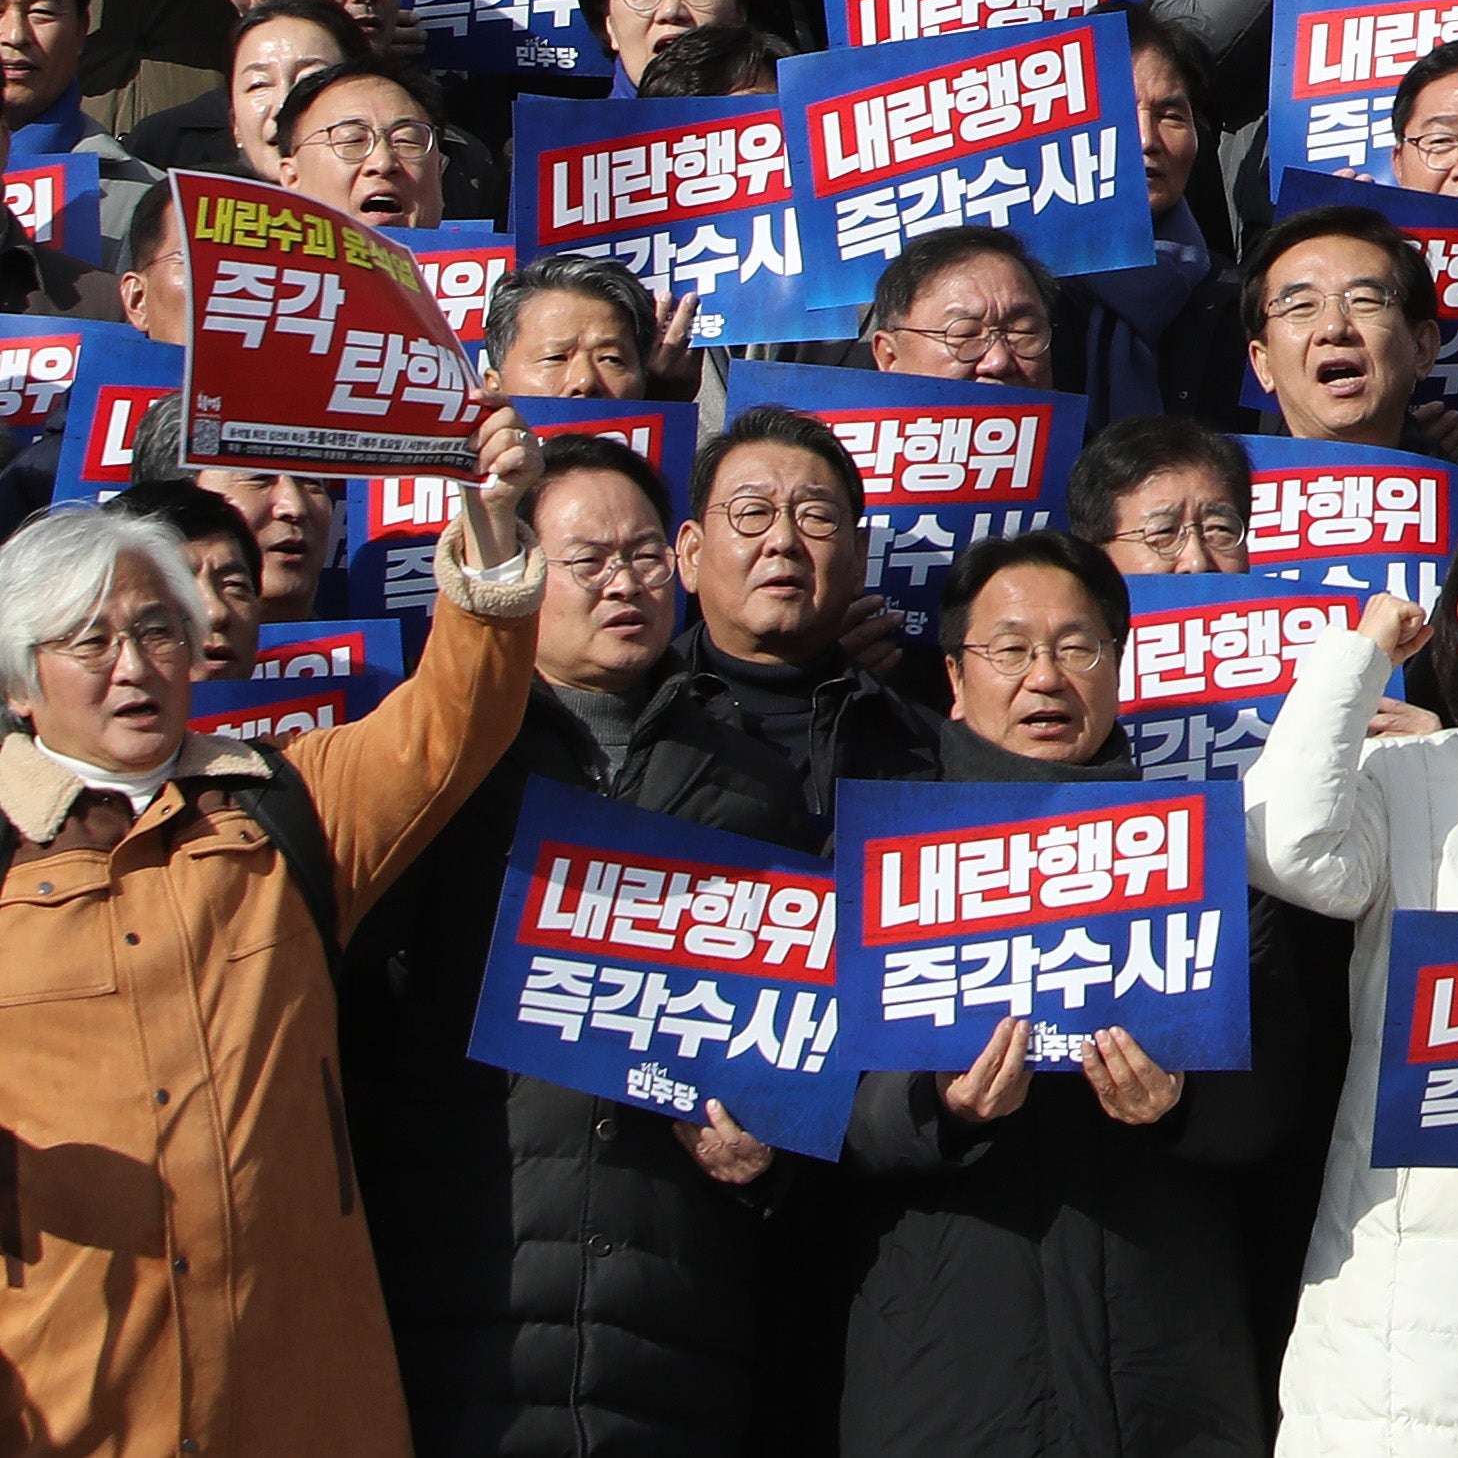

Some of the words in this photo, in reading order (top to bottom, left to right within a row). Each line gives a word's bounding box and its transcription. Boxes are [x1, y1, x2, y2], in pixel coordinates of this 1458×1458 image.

[516, 46, 578, 69] 민주당
[822, 42, 1088, 183] 내란행위
[195, 197, 337, 261] 내란수괴
[202, 258, 346, 354] 즉각
[325, 329, 483, 424] 탄핵
[536, 857, 836, 973] 내란행위
[880, 809, 1189, 931] 내란행위
[518, 955, 838, 1074] 즉각수사!
[880, 909, 1221, 1027] 즉각수사!
[626, 1070, 698, 1112] 민주당
